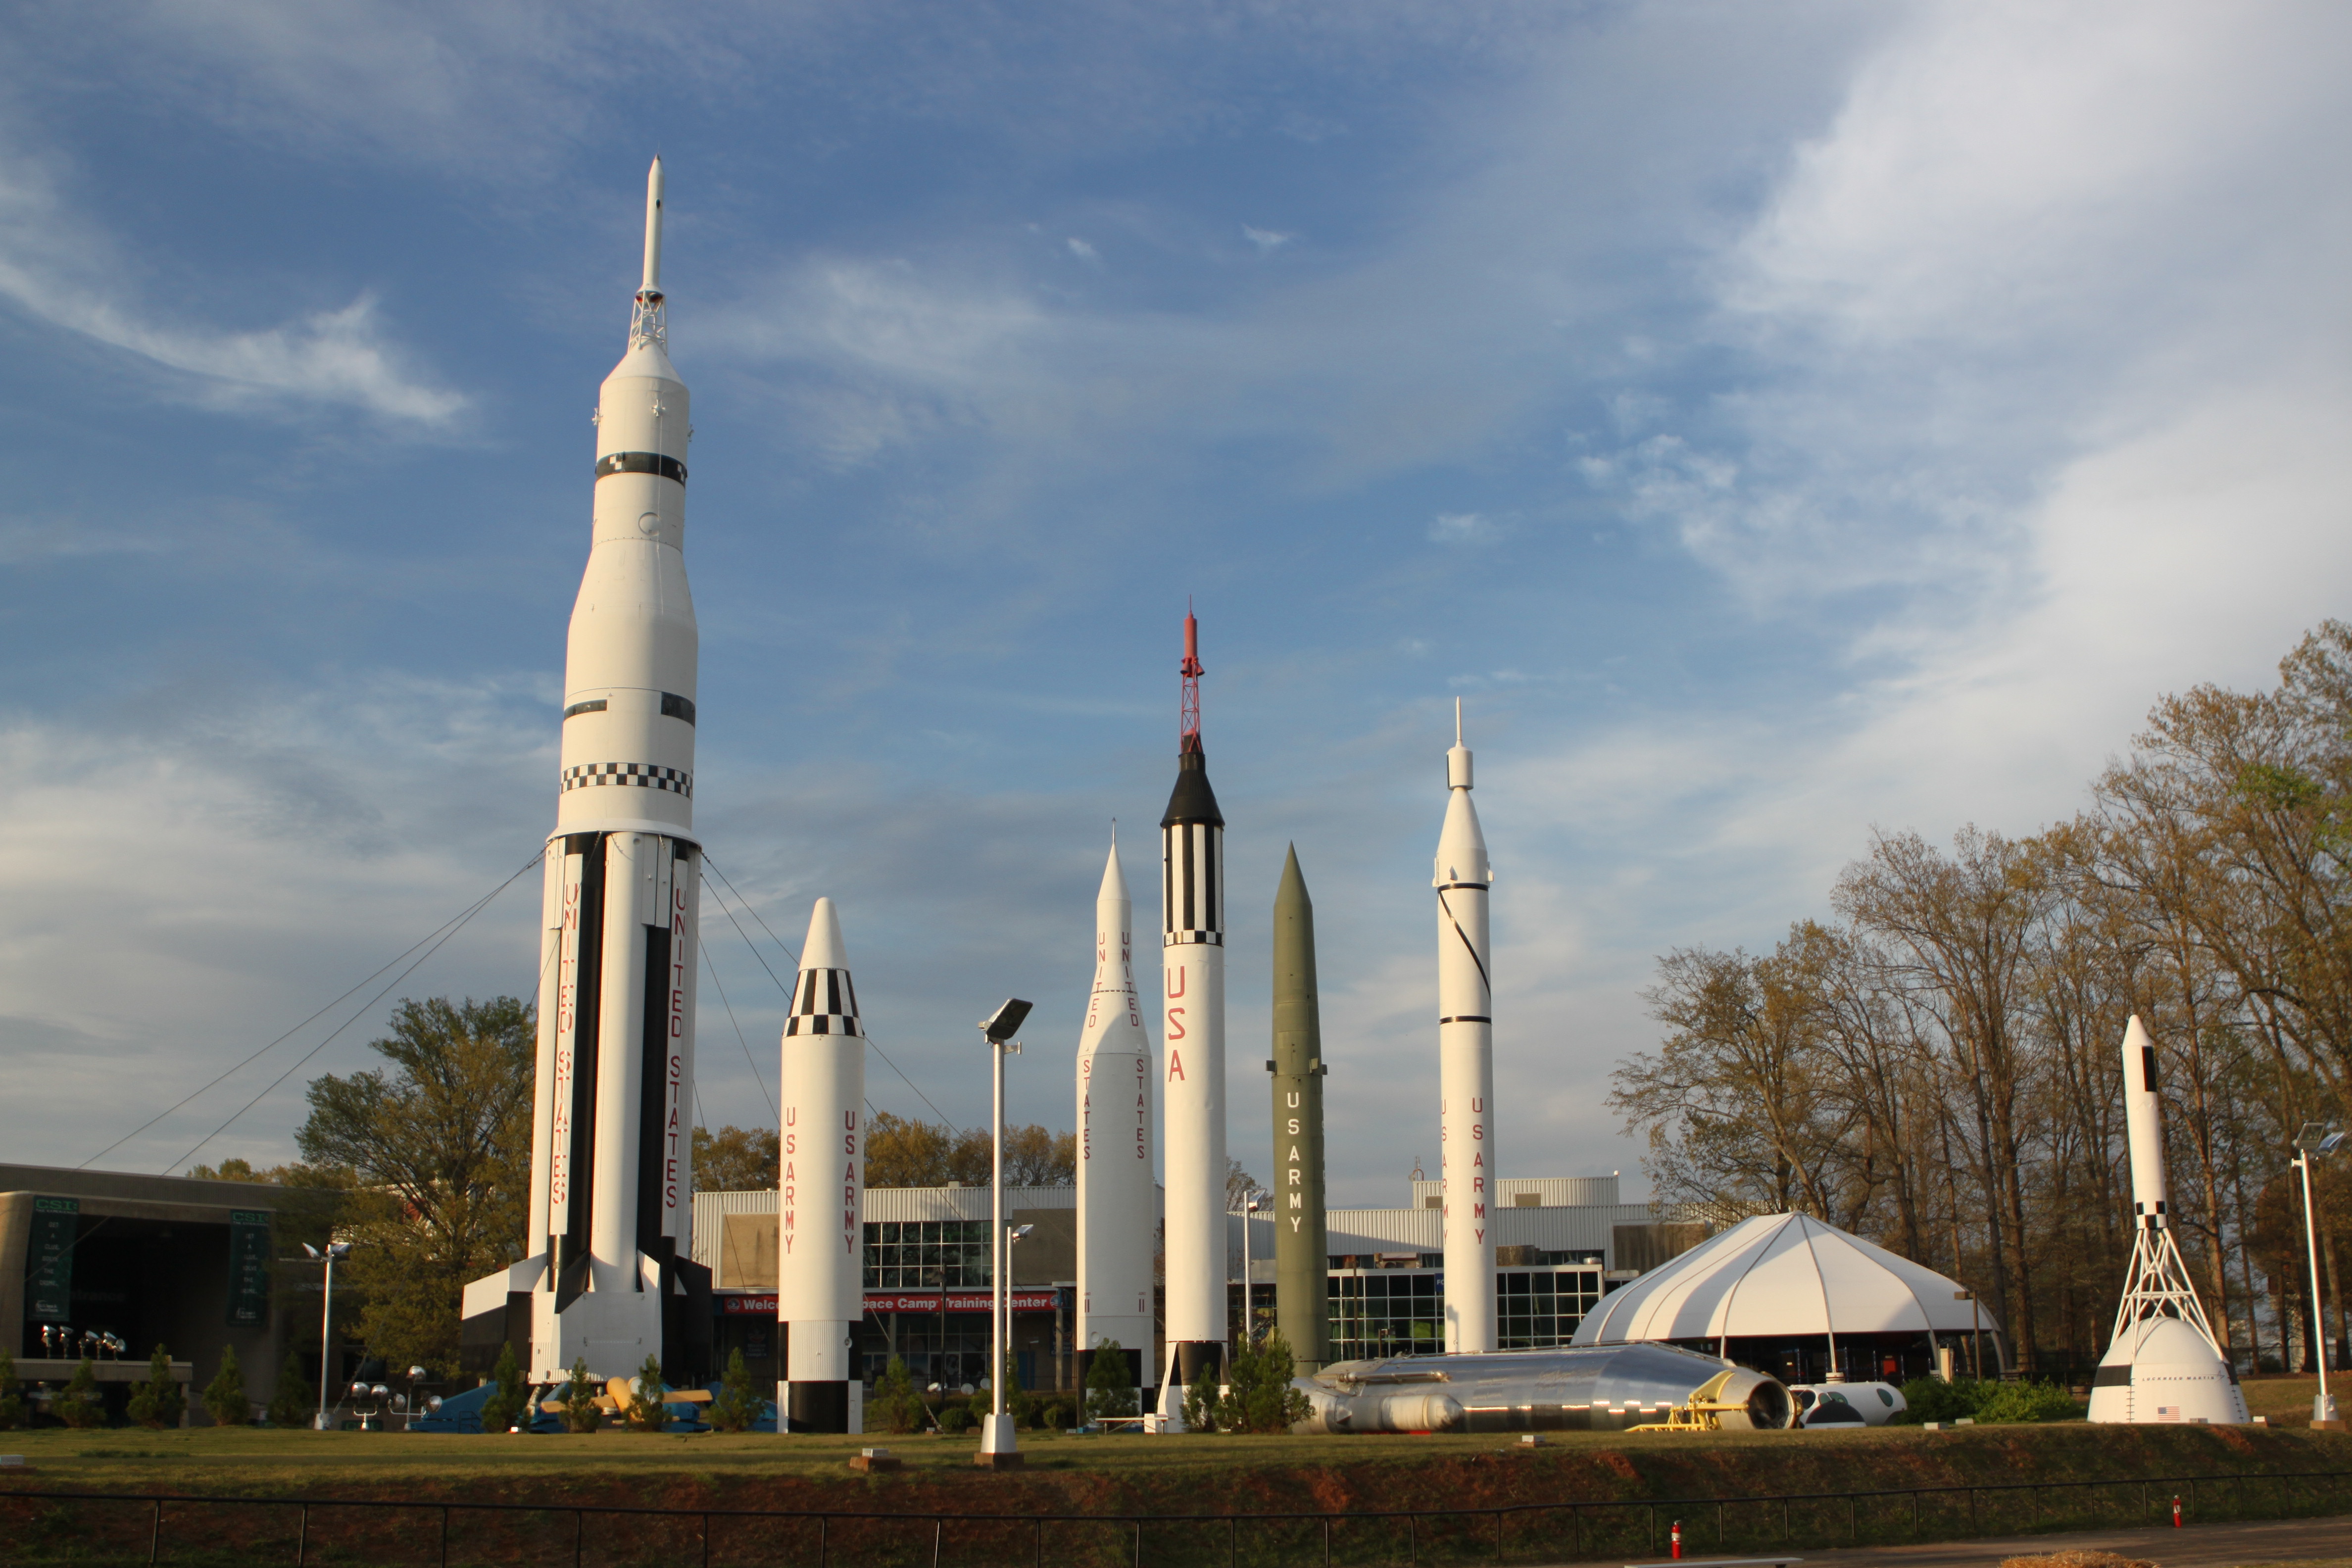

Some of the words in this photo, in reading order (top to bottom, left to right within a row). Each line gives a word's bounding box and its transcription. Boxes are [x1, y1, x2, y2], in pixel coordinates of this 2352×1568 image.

[559, 883, 578, 1033] UNITED
[671, 888, 686, 1037] UNITED
[1088, 931, 1105, 1028] UNITED
[1122, 931, 1139, 1027] UNITED
[1167, 965, 1185, 1082] USA
[552, 1050, 571, 1204] STATES
[665, 1055, 681, 1208] STATES
[36, 1199, 78, 1211] CSI:
[743, 1299, 779, 1310] Welc
[897, 1298, 936, 1310] Camp
[940, 1297, 993, 1310] Training
